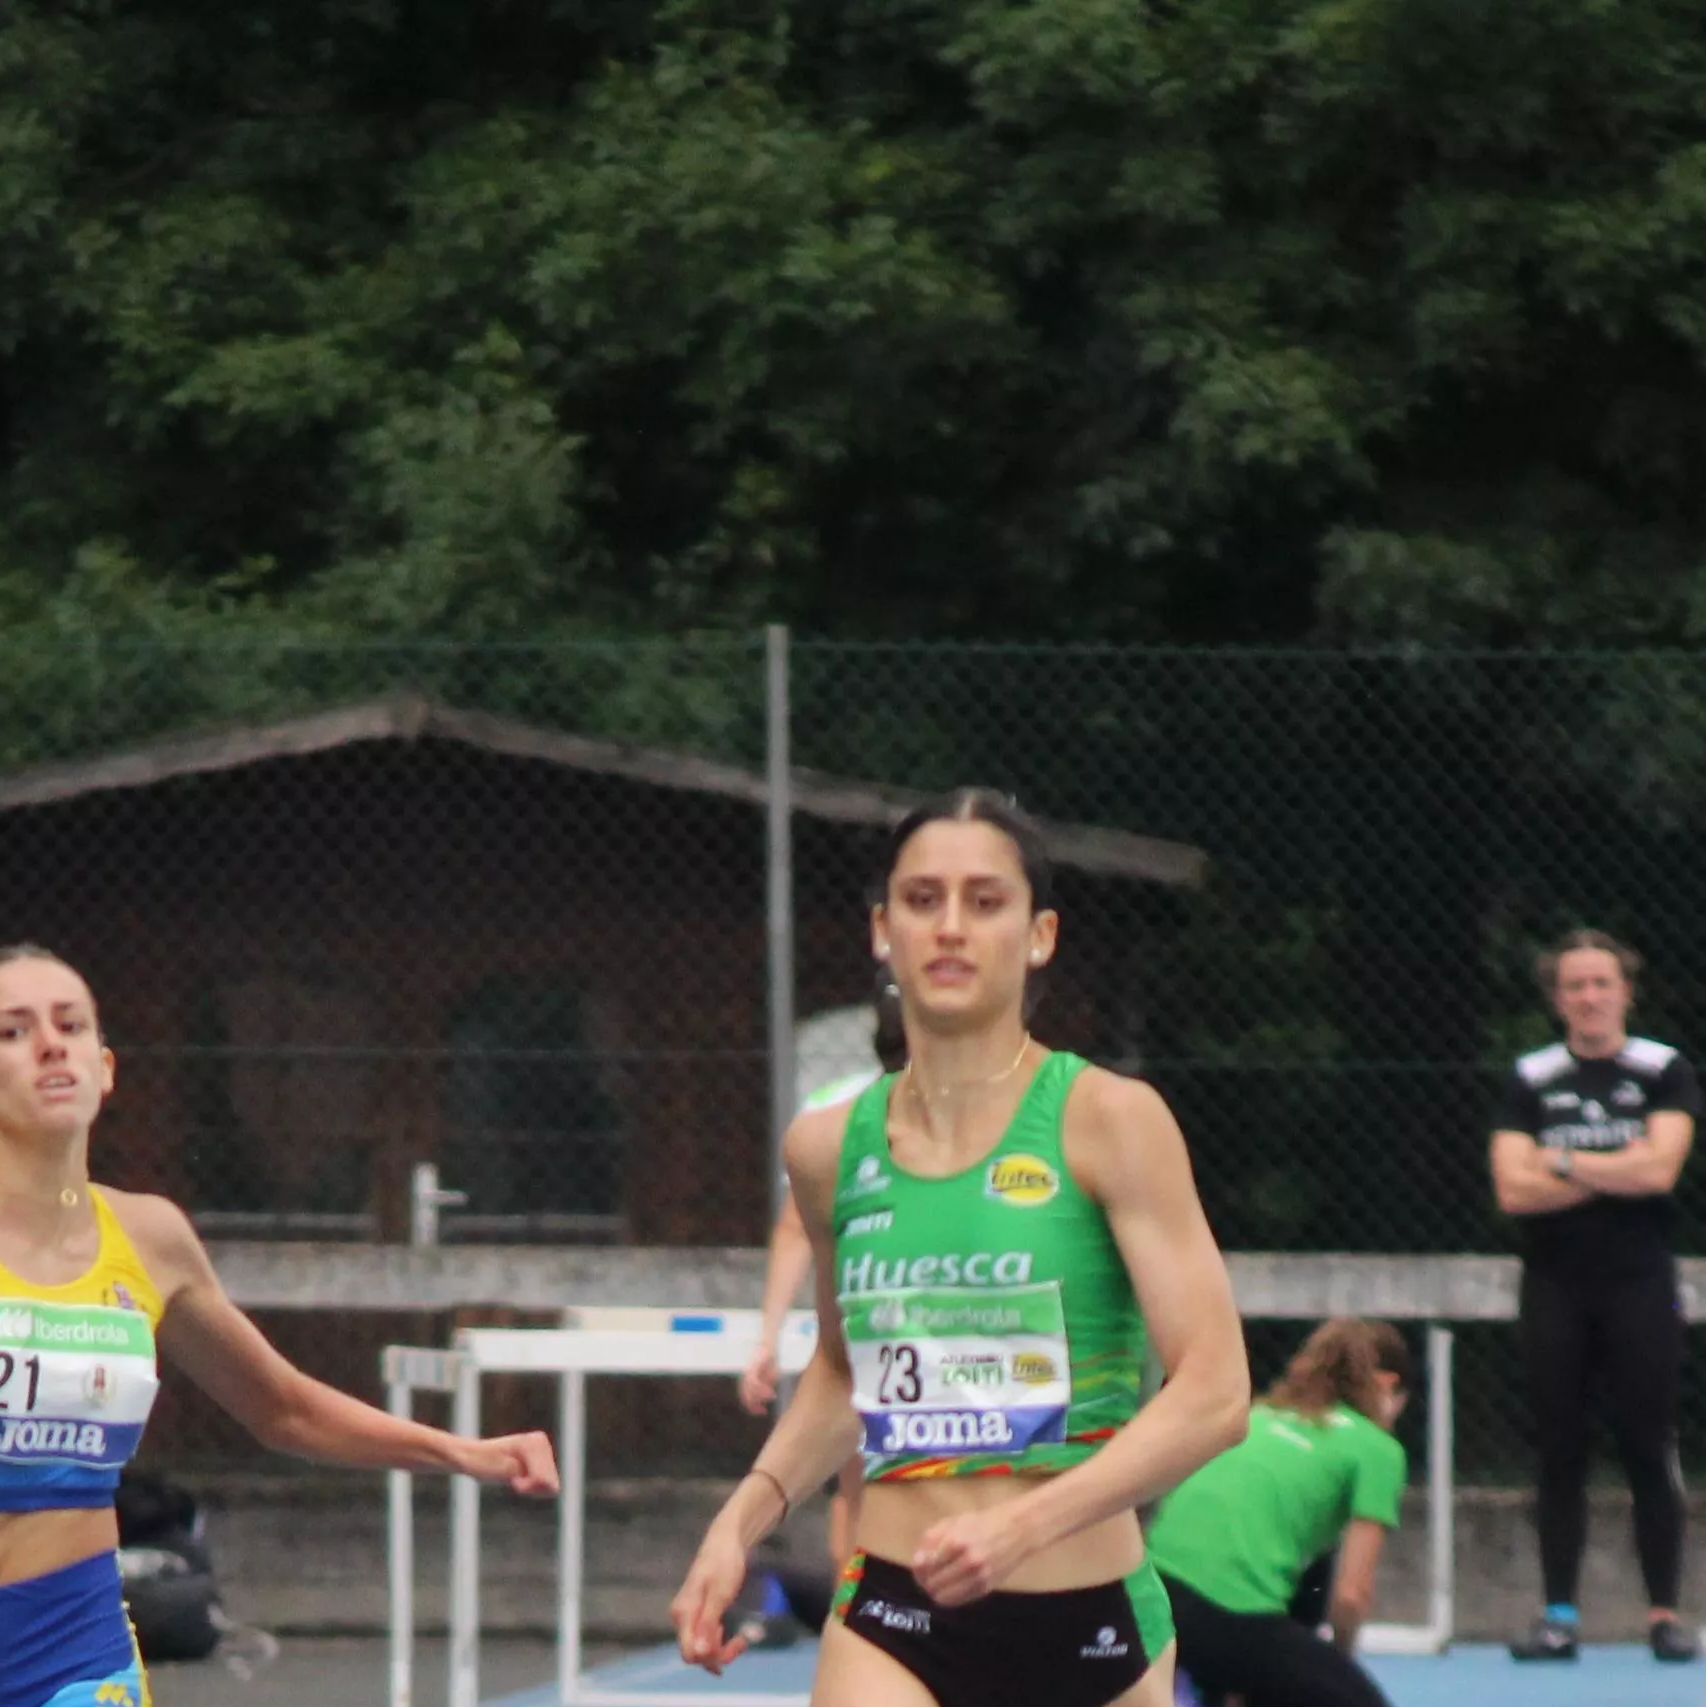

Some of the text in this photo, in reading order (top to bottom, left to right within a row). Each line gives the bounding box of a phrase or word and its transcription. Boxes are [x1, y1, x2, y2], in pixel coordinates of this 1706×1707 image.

[842, 1252, 1033, 1293] Huesca
[35, 1318, 130, 1346] Iberdrola
[878, 1343, 923, 1404] 23
[883, 1410, 1013, 1452] Joma
